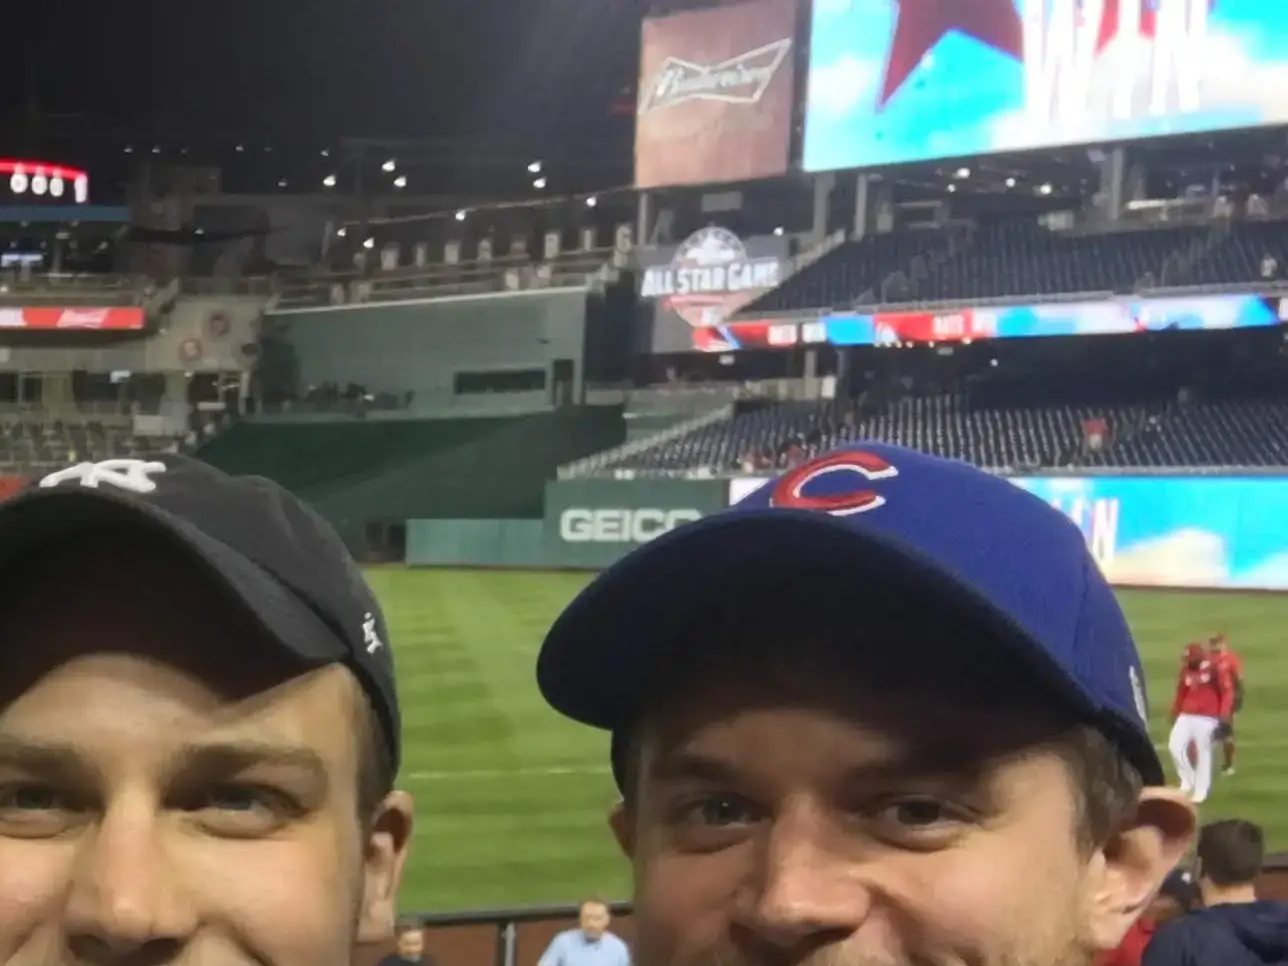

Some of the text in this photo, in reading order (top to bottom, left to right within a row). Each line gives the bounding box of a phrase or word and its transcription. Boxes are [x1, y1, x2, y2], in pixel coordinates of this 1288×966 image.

[640, 269, 675, 297] ALL
[677, 266, 726, 294] STAR
[770, 450, 899, 516] C
